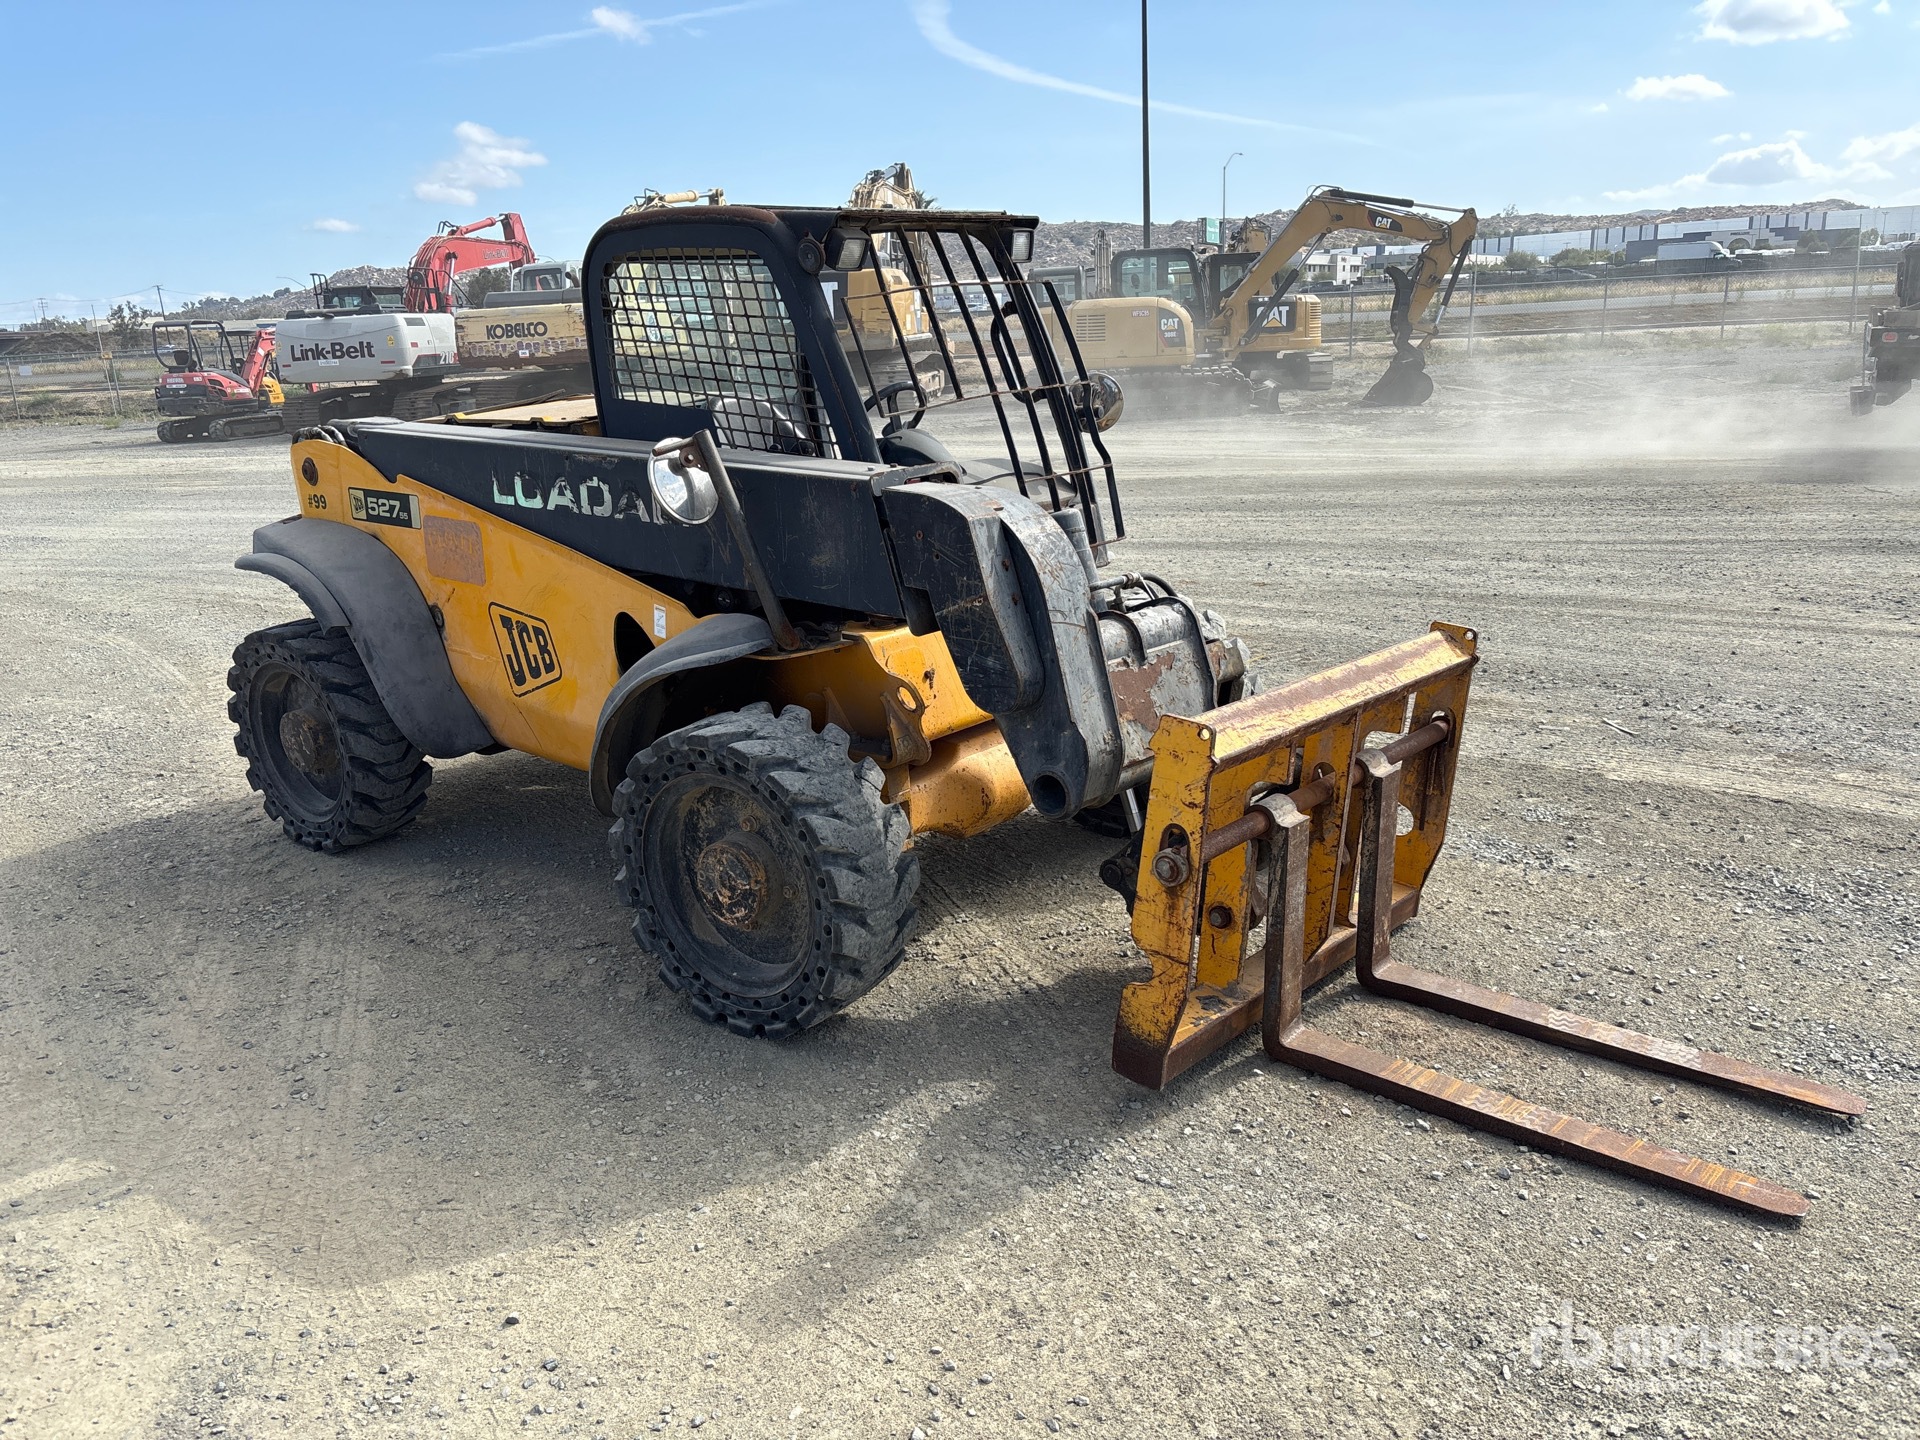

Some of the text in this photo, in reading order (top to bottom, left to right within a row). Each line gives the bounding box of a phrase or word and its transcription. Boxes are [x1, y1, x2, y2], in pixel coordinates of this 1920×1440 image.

[1375, 216, 1393, 229] CAT
[486, 321, 548, 340] KOBELCO
[1160, 318, 1179, 331] CAT
[290, 340, 376, 362] Link-Belt
[308, 493, 327, 510] #99
[367, 496, 401, 518] 527
[491, 470, 690, 528] LOADA
[498, 613, 556, 687] JCB
